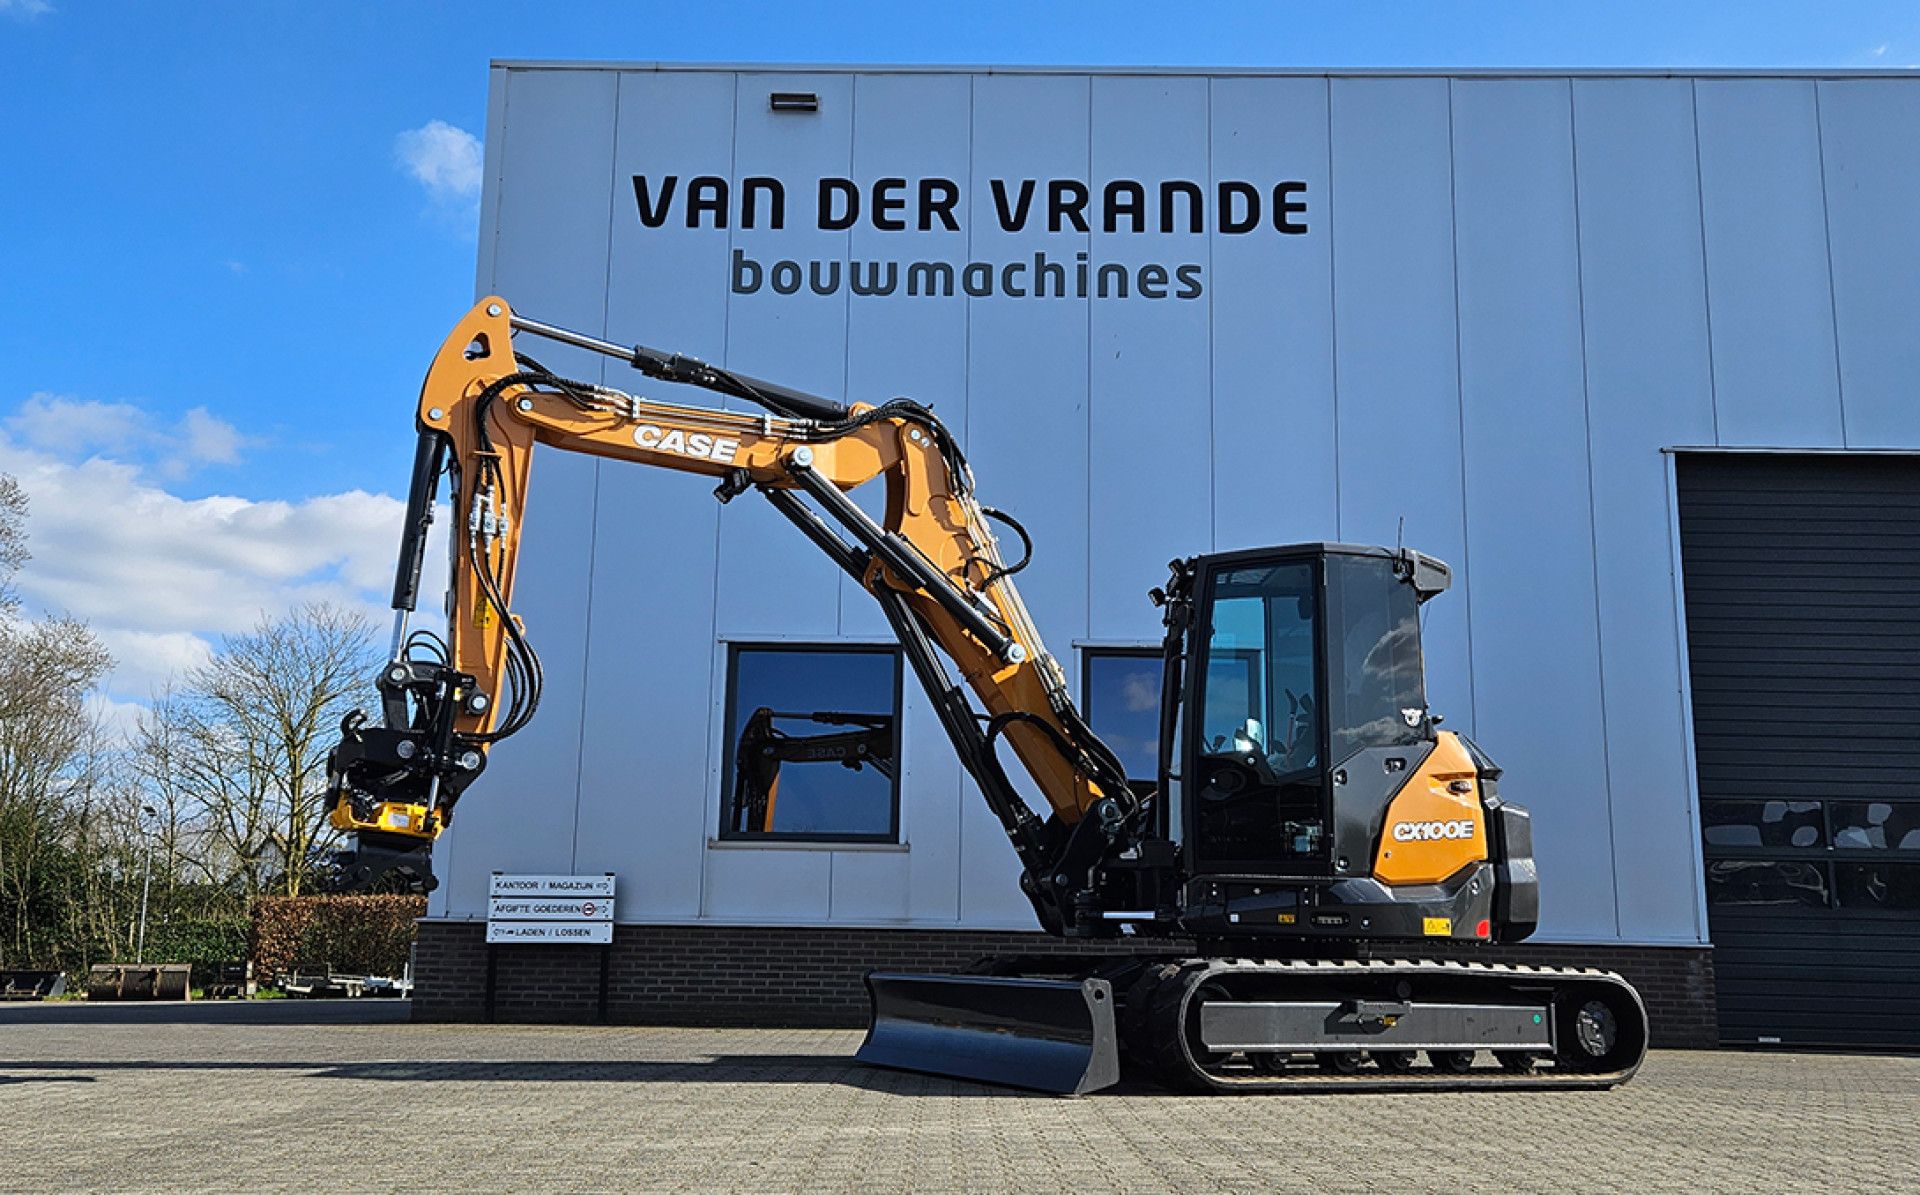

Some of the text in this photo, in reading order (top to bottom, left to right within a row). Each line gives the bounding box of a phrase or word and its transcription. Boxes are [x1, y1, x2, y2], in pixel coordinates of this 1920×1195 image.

[632, 175, 1308, 235] VAN DER VRANDE
[731, 249, 1204, 299] bouwmachines
[633, 424, 739, 464] CASE
[1393, 820, 1474, 841] CX100E
[494, 881, 539, 890] KANTOOR
[494, 904, 581, 914] AFGIFTE GOEDEREN
[515, 928, 546, 937] LADEN
[555, 928, 592, 937] LOSSEN
